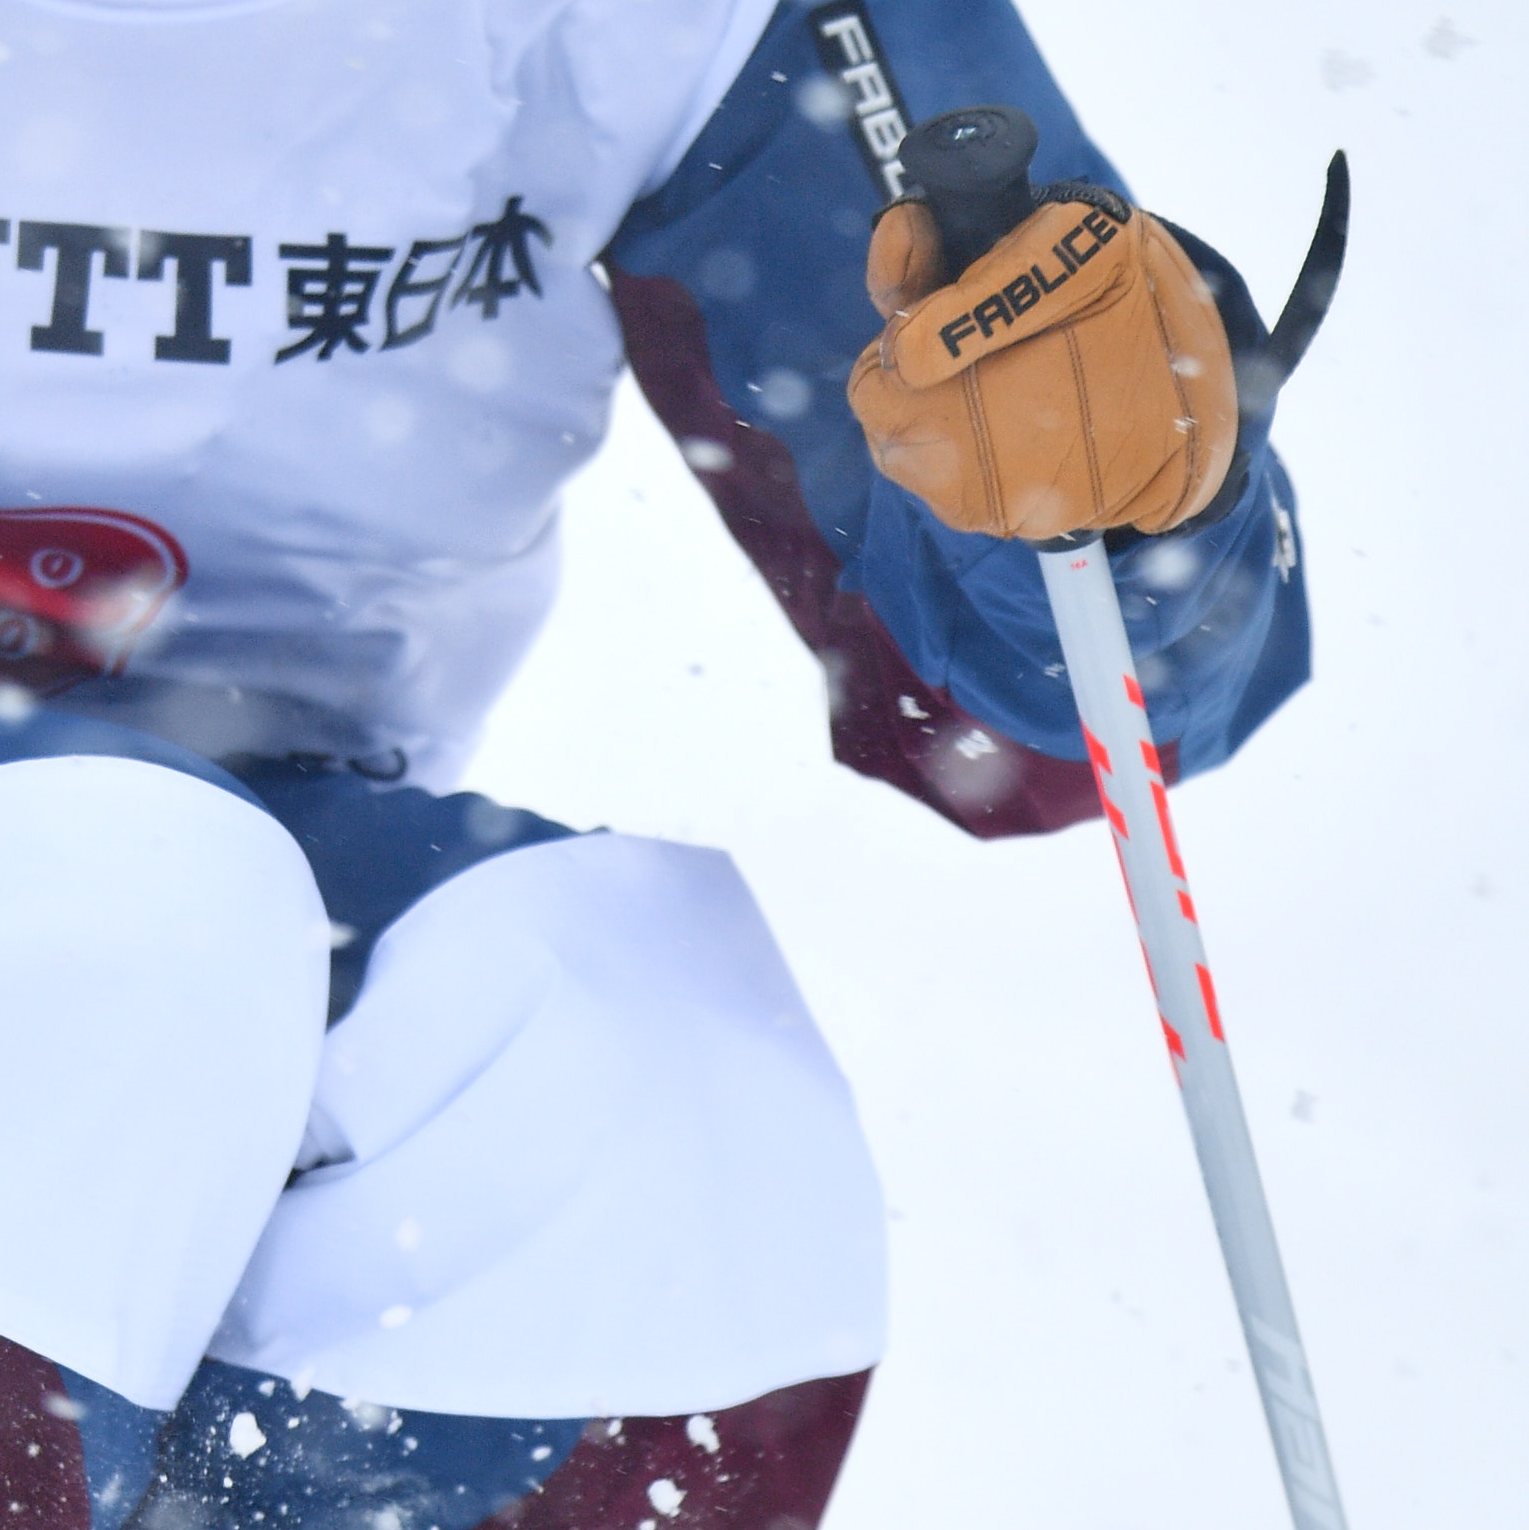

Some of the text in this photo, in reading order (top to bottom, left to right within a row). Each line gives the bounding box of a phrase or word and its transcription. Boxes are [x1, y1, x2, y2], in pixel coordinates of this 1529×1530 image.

[821, 14, 908, 199] FABL
[274, 195, 553, 364] 東日本
[938, 209, 1118, 359] FABLICE
